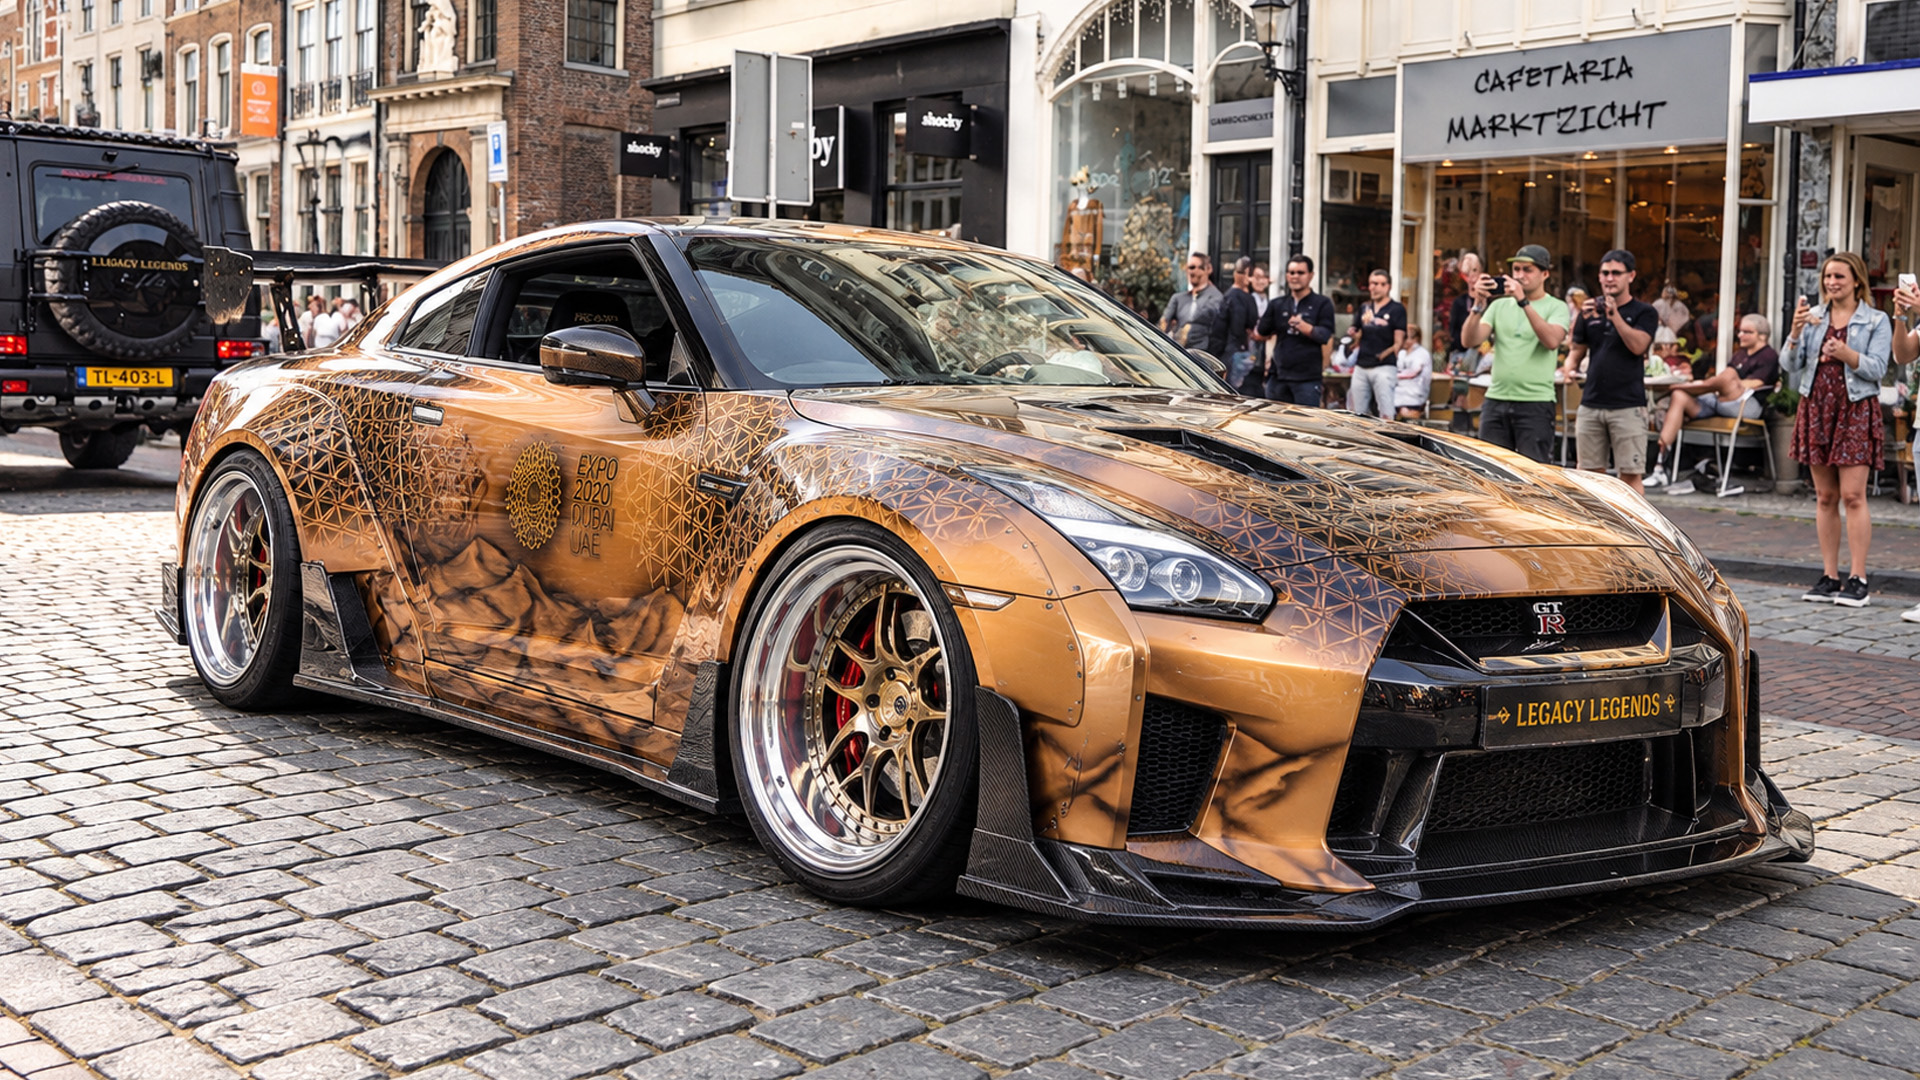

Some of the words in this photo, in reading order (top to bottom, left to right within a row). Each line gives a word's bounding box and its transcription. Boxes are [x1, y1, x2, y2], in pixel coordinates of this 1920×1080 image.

[1474, 55, 1633, 94] CAFETARIA
[1447, 101, 1667, 143] MARKTZICHT
[92, 369, 165, 384] TL-403-L
[577, 454, 618, 481] EXPO
[573, 479, 611, 505] 2020
[571, 503, 615, 532] DUBAI
[570, 530, 600, 557] UAE
[1533, 601, 1563, 614] GT
[1537, 614, 1567, 635] R
[1516, 699, 1585, 727] LEGACY
[1590, 692, 1661, 722] LEGENDS
